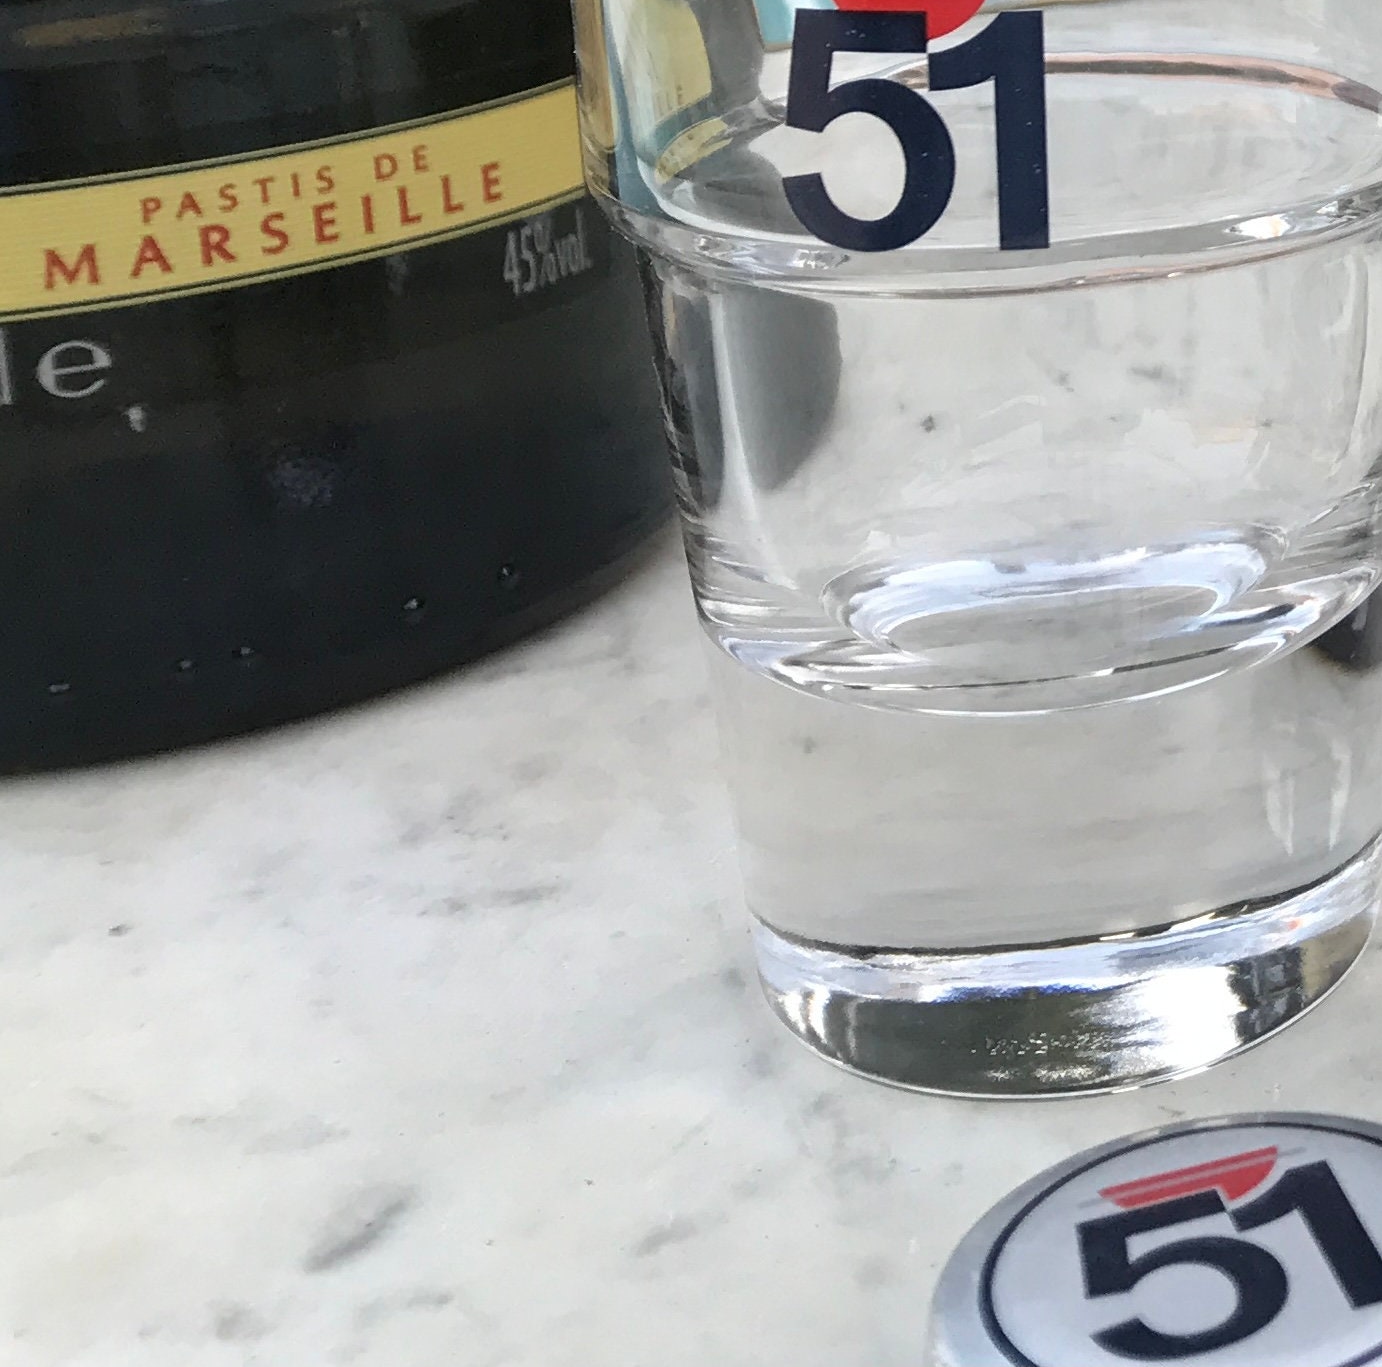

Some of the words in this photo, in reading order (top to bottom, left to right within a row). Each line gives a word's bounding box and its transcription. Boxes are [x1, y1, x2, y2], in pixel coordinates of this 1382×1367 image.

[139, 164, 337, 224] PASTIS
[373, 143, 432, 181] DE
[782, 7, 1050, 253] 51
[42, 160, 506, 291] MARSEILLE
